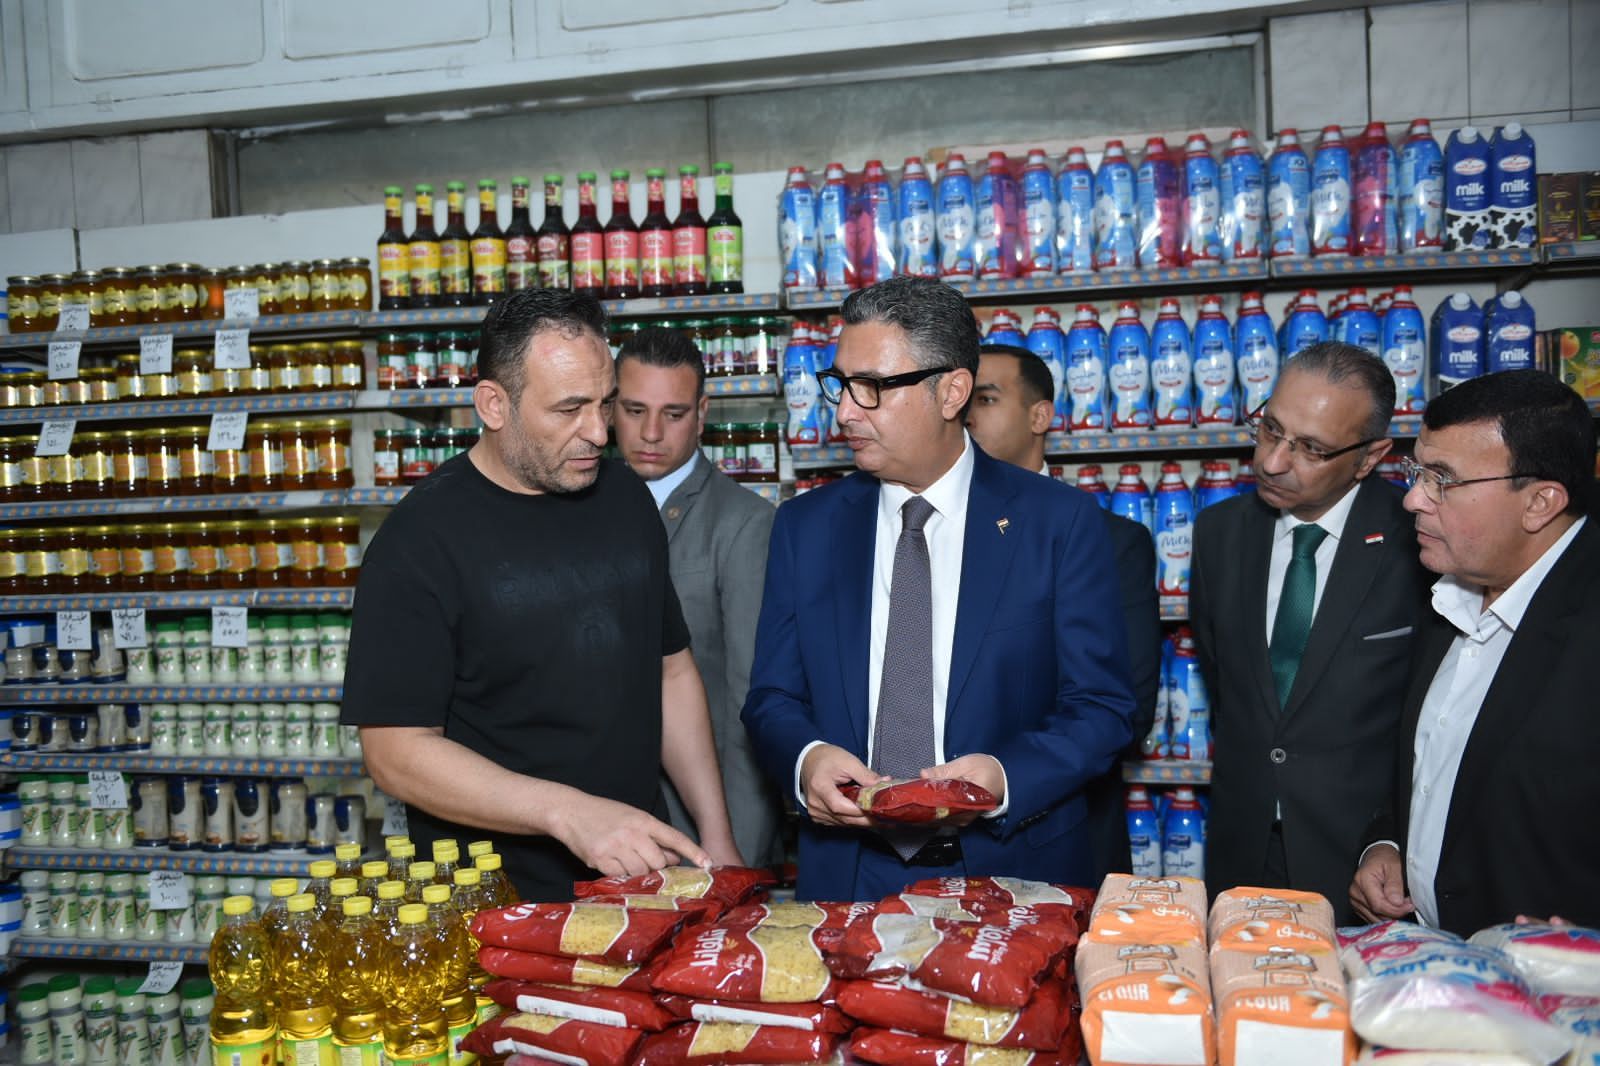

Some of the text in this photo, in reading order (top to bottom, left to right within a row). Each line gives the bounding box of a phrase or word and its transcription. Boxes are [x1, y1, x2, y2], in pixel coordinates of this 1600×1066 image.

[1456, 182, 1485, 196] milk
[1500, 179, 1530, 193] milk
[1449, 350, 1477, 363] milk
[1500, 348, 1530, 361] milk
[1161, 535, 1191, 547] Milk
